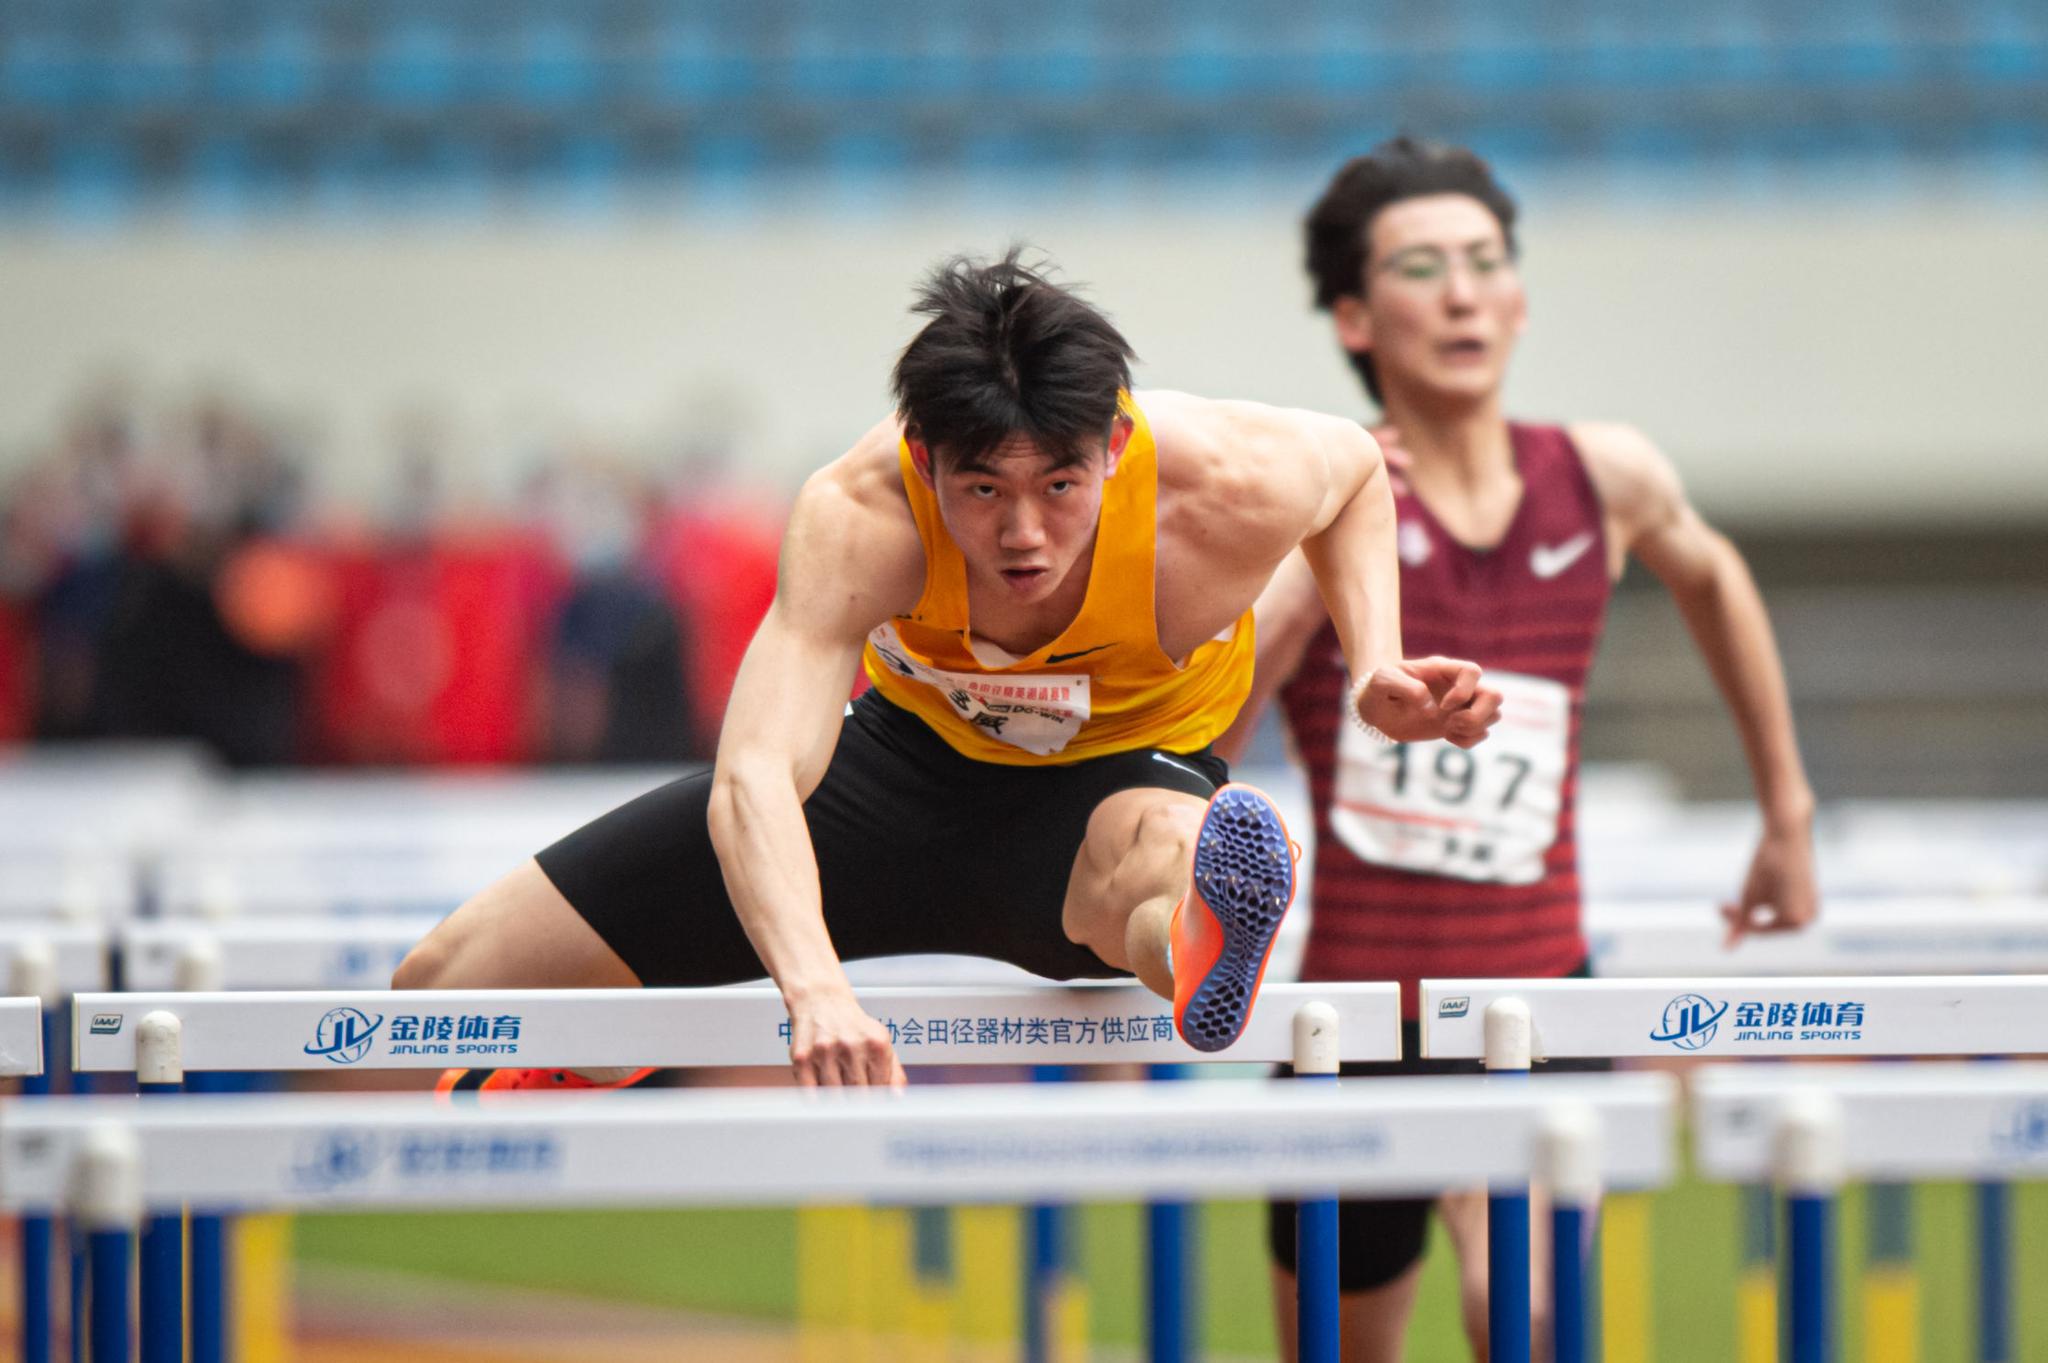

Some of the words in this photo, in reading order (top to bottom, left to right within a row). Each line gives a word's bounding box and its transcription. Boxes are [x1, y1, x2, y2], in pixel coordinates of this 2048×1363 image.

[1375, 742, 1532, 811] 197
[389, 1014, 522, 1041] 金陵体育
[1733, 1001, 1865, 1028] 金陵体育
[777, 1017, 1174, 1046] 中协会田径器材类官方供应商
[1733, 1029, 1793, 1041] JINLING
[1799, 1029, 1862, 1041] SPORTS
[389, 1043, 449, 1055] JINLING
[456, 1043, 519, 1055] SPORTS
